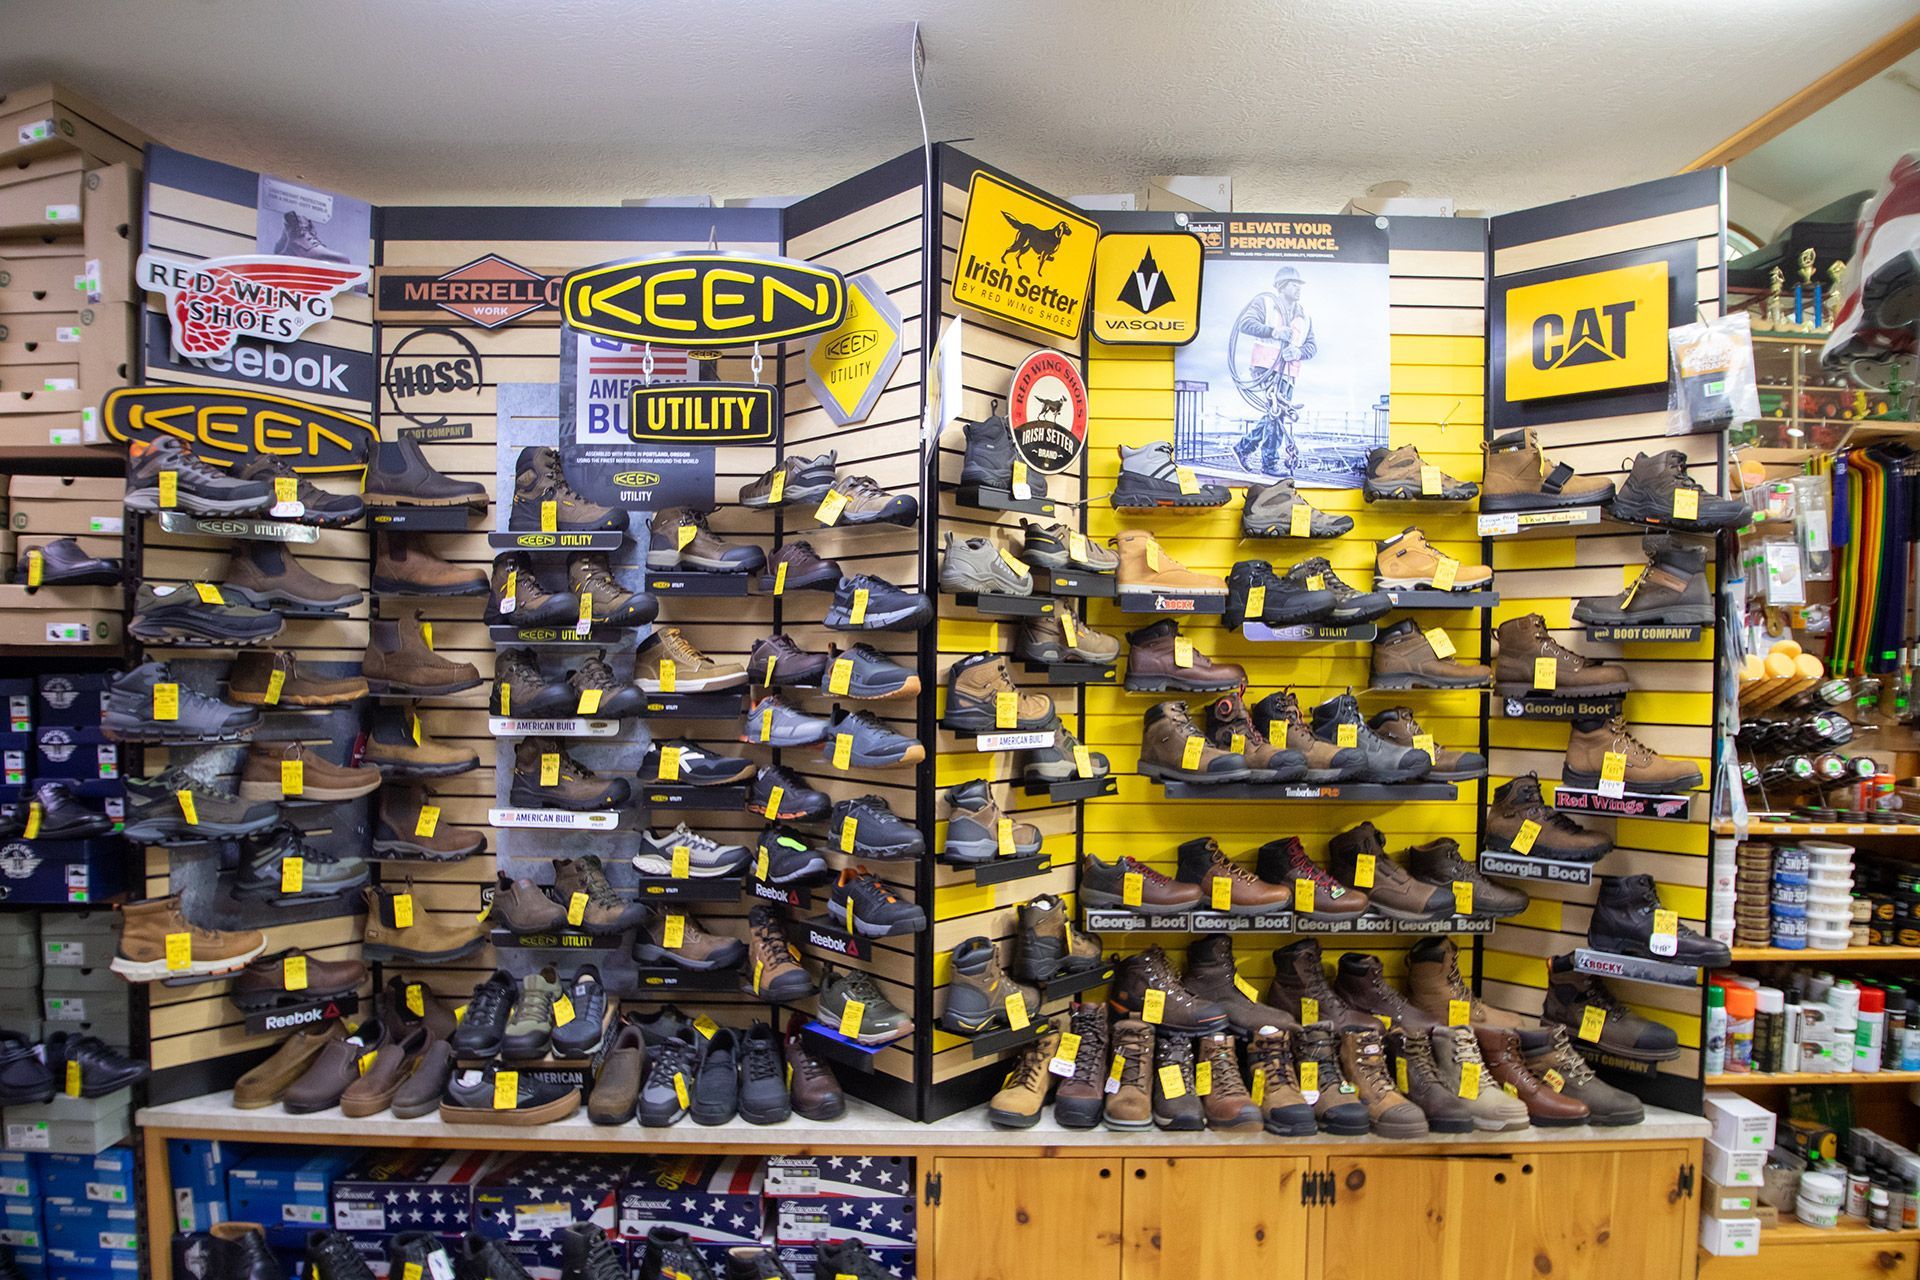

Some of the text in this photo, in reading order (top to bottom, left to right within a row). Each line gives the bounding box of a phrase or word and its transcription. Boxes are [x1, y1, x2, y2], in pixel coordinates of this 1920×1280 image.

[1229, 222, 1332, 236] ELEVATE YOUR
[1229, 237, 1339, 251] PERFORMANCE.
[149, 262, 327, 317] RED WING
[404, 281, 544, 301] MERRELL
[964, 255, 1079, 315] Irish Setter
[578, 267, 827, 332] KEEN
[961, 282, 1072, 328] BY RED WING SHOES
[189, 300, 292, 337] SHOES
[473, 306, 509, 317] WORK
[1105, 320, 1185, 331] VASQUE
[1531, 300, 1636, 371] CAT
[825, 331, 877, 358] KEEN
[688, 350, 723, 359] KEEN
[392, 358, 474, 399] HOSS
[830, 361, 871, 384] UTILITY
[1015, 359, 1084, 418] RED WING SHOES
[647, 396, 756, 431] UTILITY
[129, 404, 352, 457] KEEN
[427, 426, 466, 438] COMPANY
[1021, 427, 1074, 455] IRISH SETTER
[1037, 447, 1058, 460] BRAND
[614, 472, 659, 486] KEEN
[620, 490, 653, 502] UTILITY
[199, 520, 288, 537] KEEN UTILITY
[519, 535, 593, 546] KEEN UTILITY
[1164, 600, 1195, 610] ROCKY
[519, 630, 556, 641] KEEN
[1274, 627, 1349, 638] KEEN UTILITY
[1613, 628, 1640, 640] BOOT
[1641, 628, 1692, 640] COMPANY
[1524, 702, 1611, 715] Georgia Boot
[516, 722, 576, 731] AMERICAN BUILT
[999, 734, 1044, 745] AMERICAN BUILT
[1285, 786, 1320, 798] Timberland
[1556, 791, 1588, 808] Red
[1591, 794, 1645, 815] Wings
[515, 812, 575, 824] AMERICAN BUILT
[1483, 857, 1587, 883] Georgia Boot
[755, 883, 788, 903] Reebok
[1090, 916, 1187, 930] Georgia Boot
[1195, 916, 1289, 930] Georgia Boot
[1298, 918, 1391, 932] Georgia Boot
[1457, 918, 1491, 931] Boot
[519, 935, 594, 947] KEEN UTILITY
[810, 931, 846, 953] Reebok
[1588, 960, 1624, 975] ROCKY
[265, 1007, 323, 1031] Reebok
[1601, 1055, 1650, 1073] COMPANY
